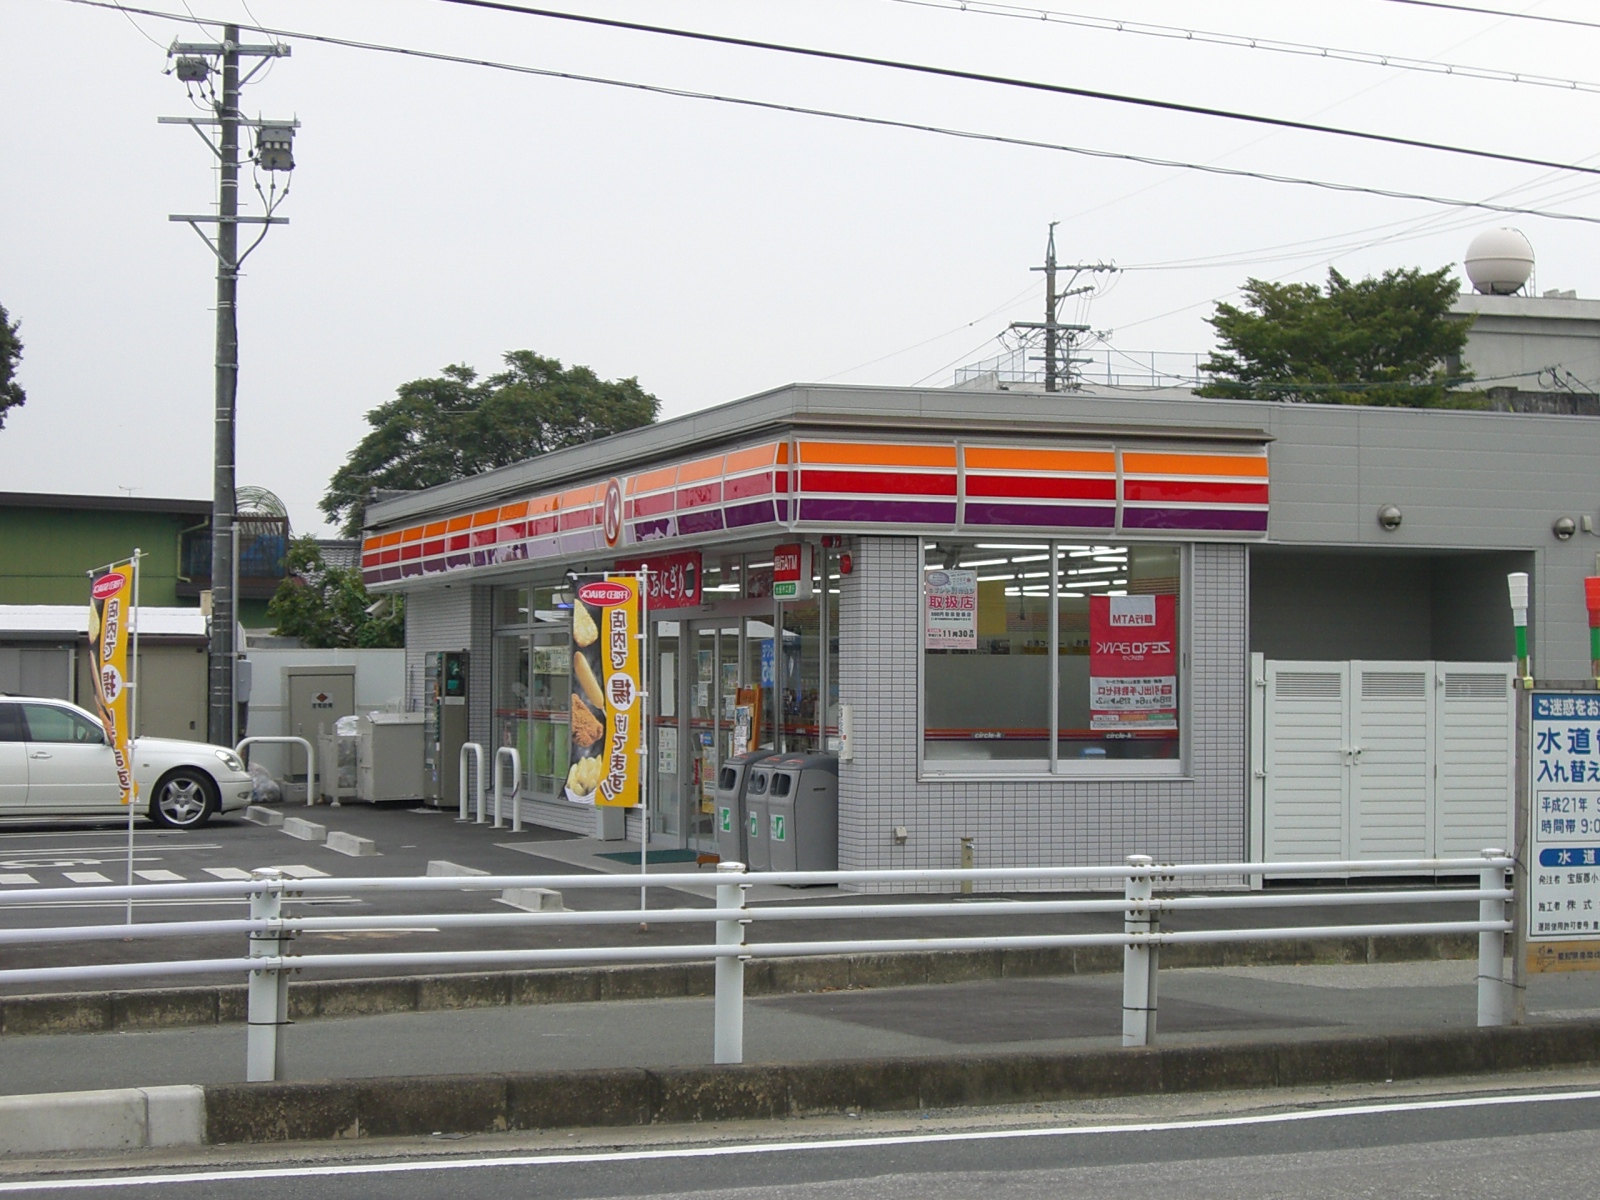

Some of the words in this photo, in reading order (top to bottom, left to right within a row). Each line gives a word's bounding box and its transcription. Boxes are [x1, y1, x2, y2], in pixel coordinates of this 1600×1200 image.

[929, 595, 974, 609] 取扱店
[1538, 698, 1600, 716] ご迷惑をお
[1537, 727, 1600, 755] 水道
[1542, 797, 1588, 813] 平成21年
[1541, 818, 1576, 834] 時間帯
[1557, 849, 1596, 865] 水道
[1538, 875, 1560, 885] 発注者
[1538, 902, 1560, 912] 施工者
